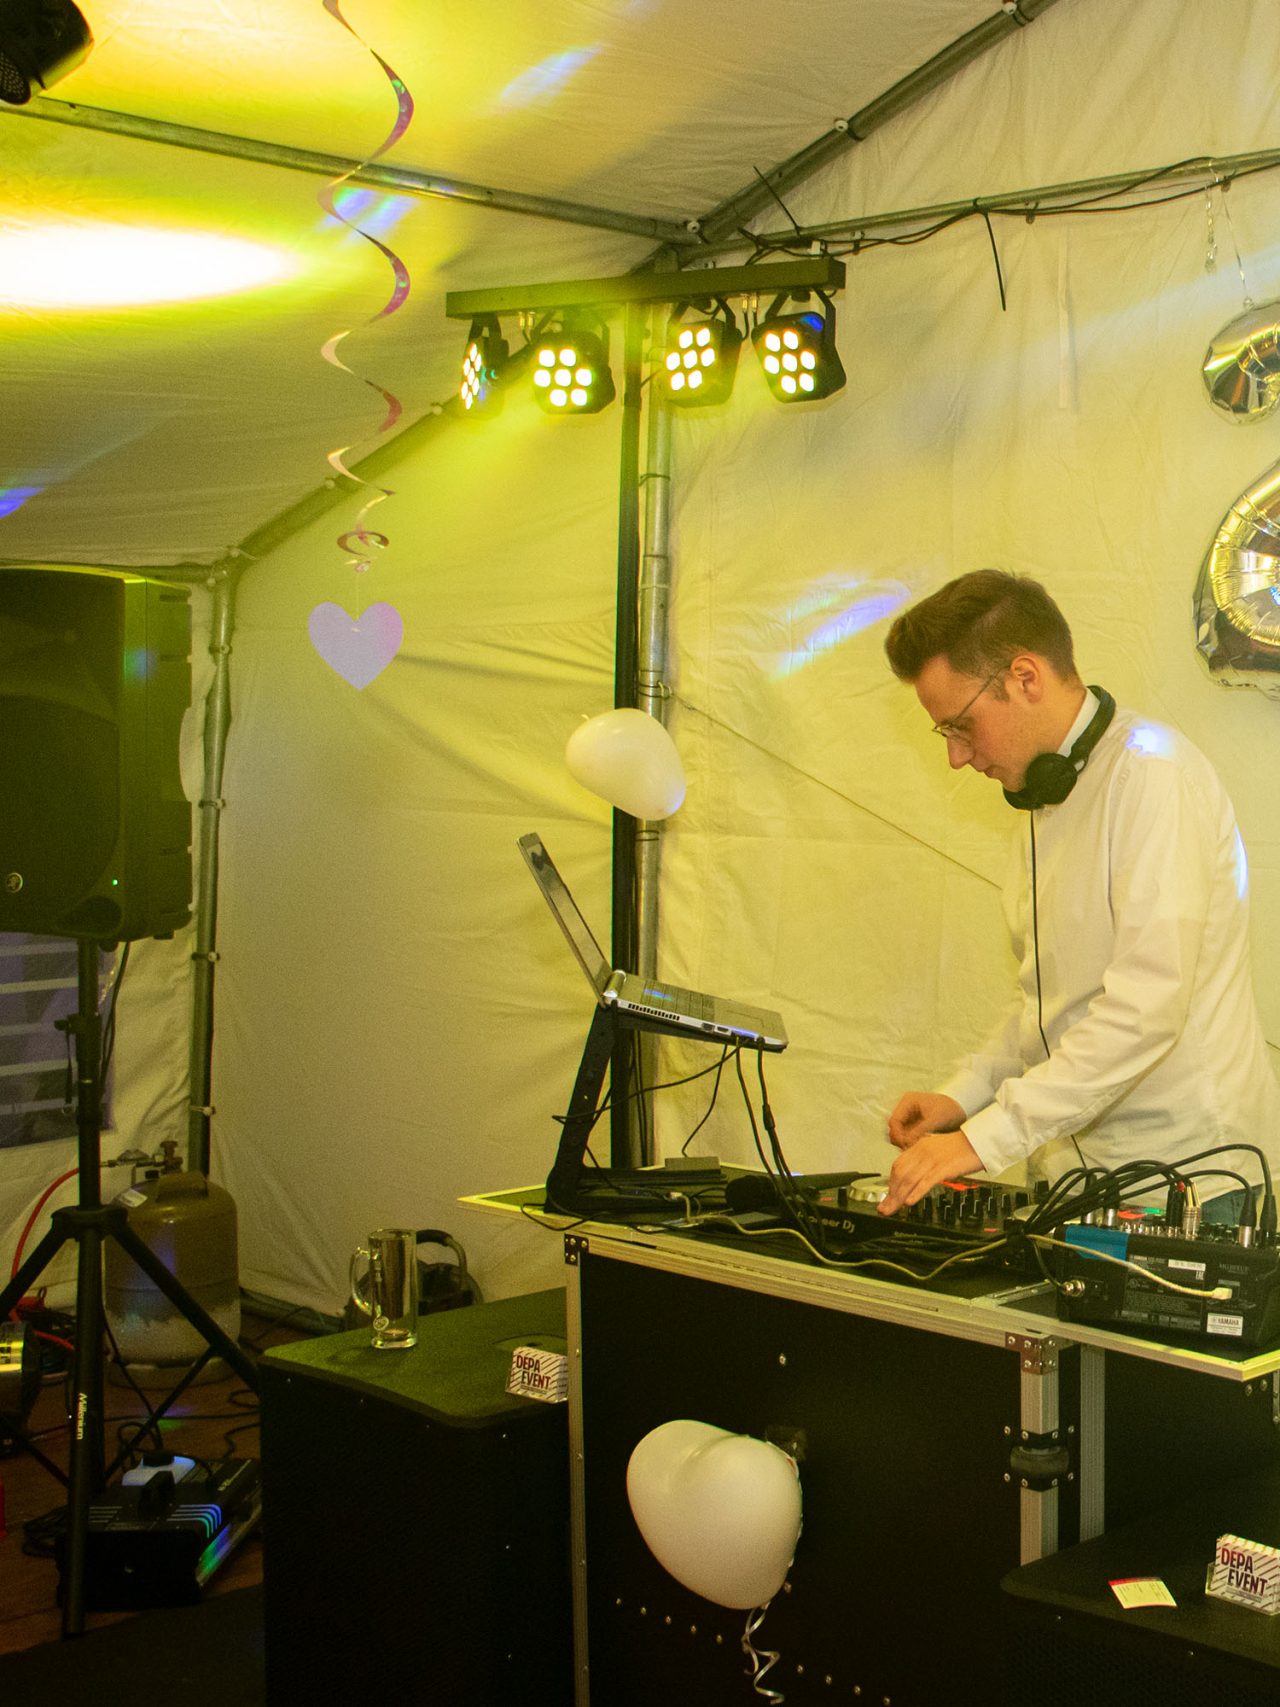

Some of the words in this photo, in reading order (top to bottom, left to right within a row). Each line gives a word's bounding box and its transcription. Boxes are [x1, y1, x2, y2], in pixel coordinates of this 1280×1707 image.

[797, 1211, 840, 1227] oeer
[1217, 1316, 1239, 1325] YAMAHA
[516, 1355, 541, 1373] DEPA
[520, 1371, 551, 1390] EVENT
[1220, 1548, 1253, 1573] DEPA
[1228, 1569, 1268, 1596] EVENT
